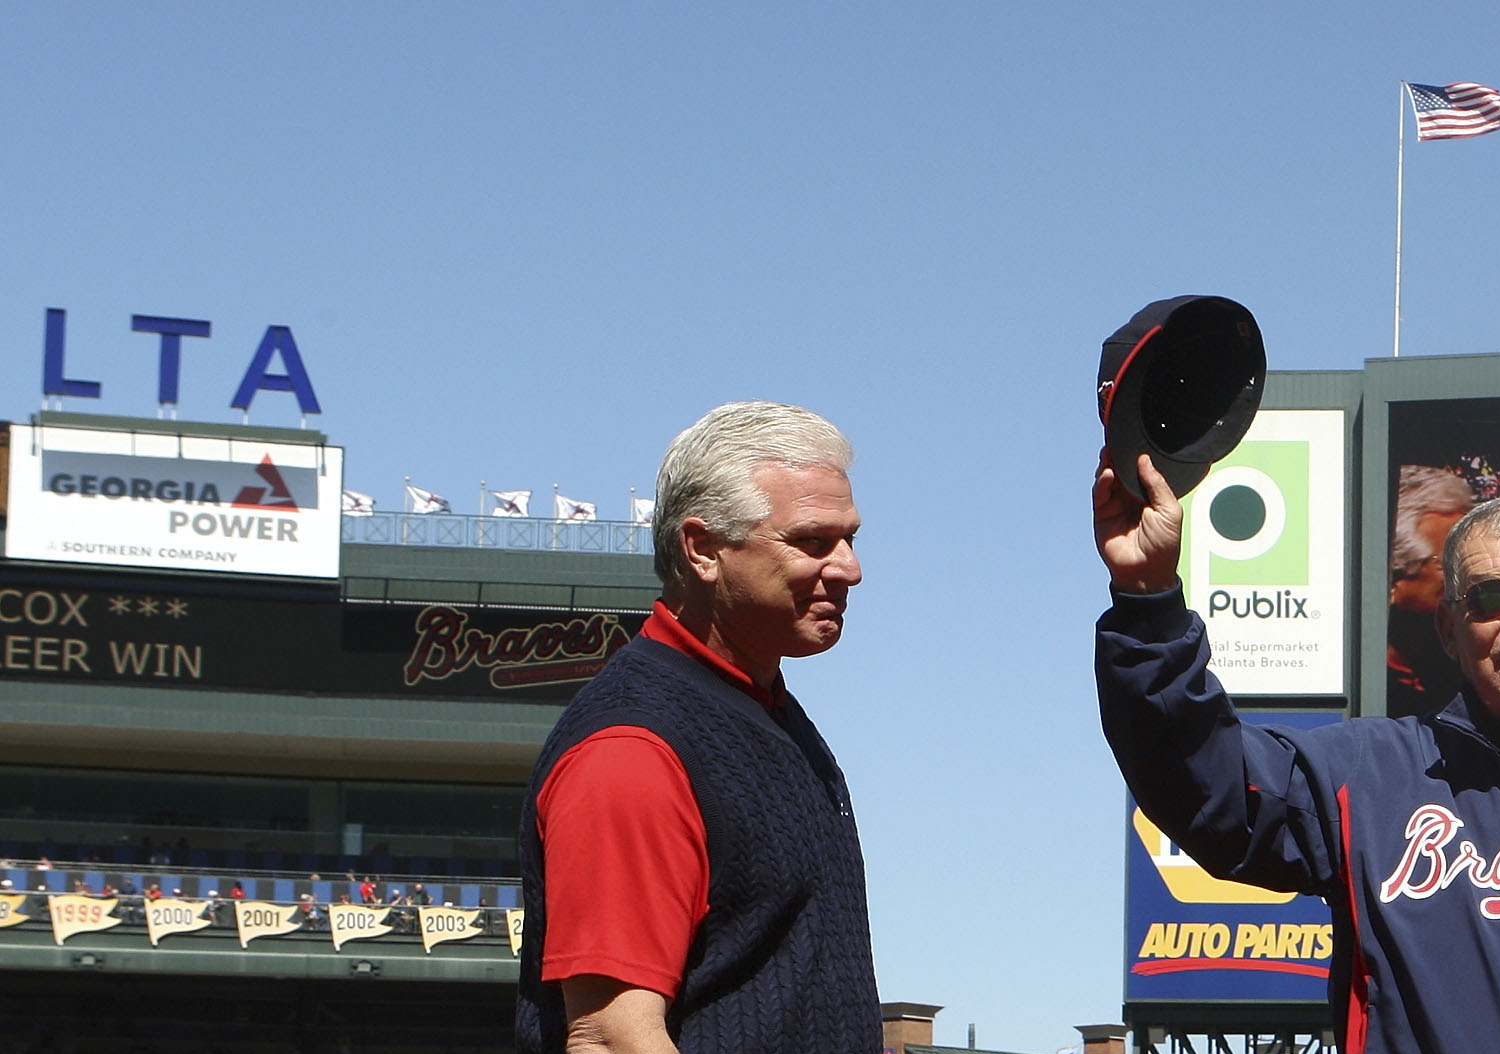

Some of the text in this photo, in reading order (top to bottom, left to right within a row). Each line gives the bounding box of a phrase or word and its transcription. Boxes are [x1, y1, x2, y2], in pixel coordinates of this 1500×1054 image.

[51, 473, 221, 507] GEORGIA
[168, 510, 299, 542] POWER
[61, 541, 152, 557] SOUTHERN
[158, 547, 239, 563] COMPANY
[0, 589, 88, 627] COX
[1209, 589, 1309, 619] Publix
[403, 605, 606, 687] Braves
[1210, 640, 1319, 656] ial Supermarket
[109, 640, 202, 679] WIN
[1209, 656, 1309, 668] Atlanta Braves.
[56, 904, 102, 924] 1999
[152, 908, 193, 926] 2000
[242, 909, 281, 929] 2001
[336, 913, 376, 930] 2002
[426, 915, 466, 933] 2003
[1138, 923, 1334, 960] AUTO PARTS
